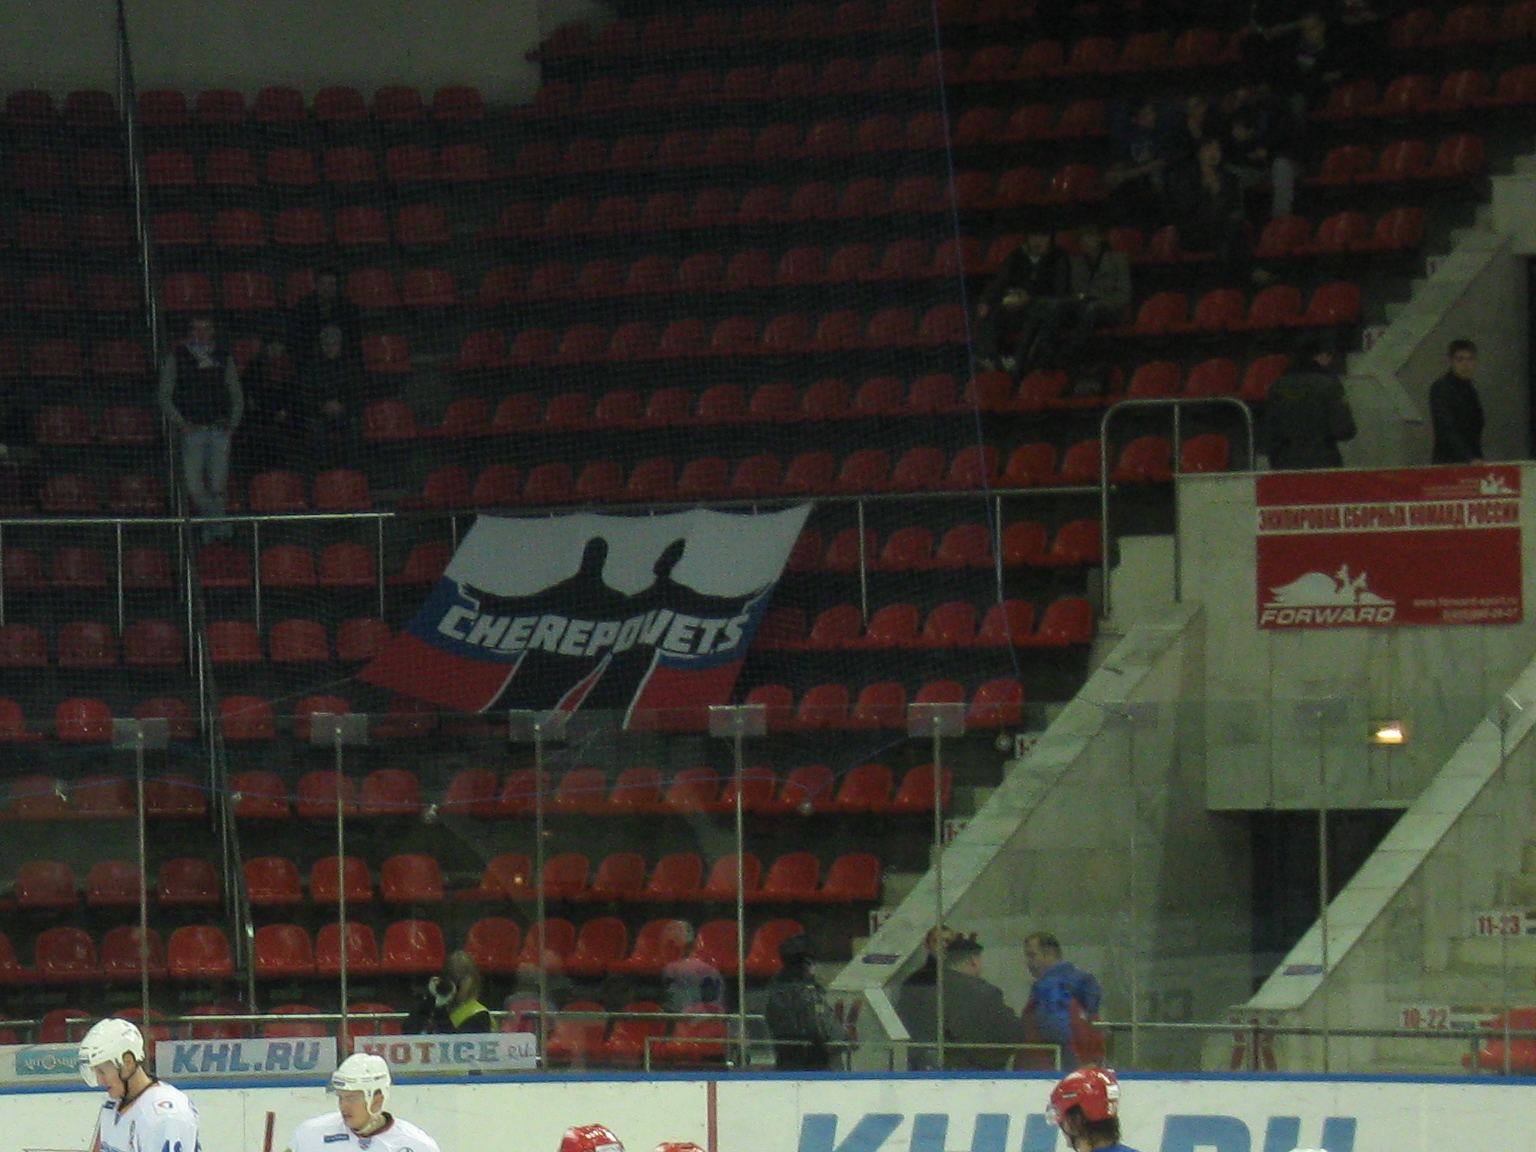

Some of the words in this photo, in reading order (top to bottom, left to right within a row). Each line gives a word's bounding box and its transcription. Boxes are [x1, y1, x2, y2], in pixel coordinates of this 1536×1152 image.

[437, 604, 750, 657] CHEREPOVETS
[1260, 606, 1396, 626] FORWARD
[173, 1041, 321, 1074] KHL.RU
